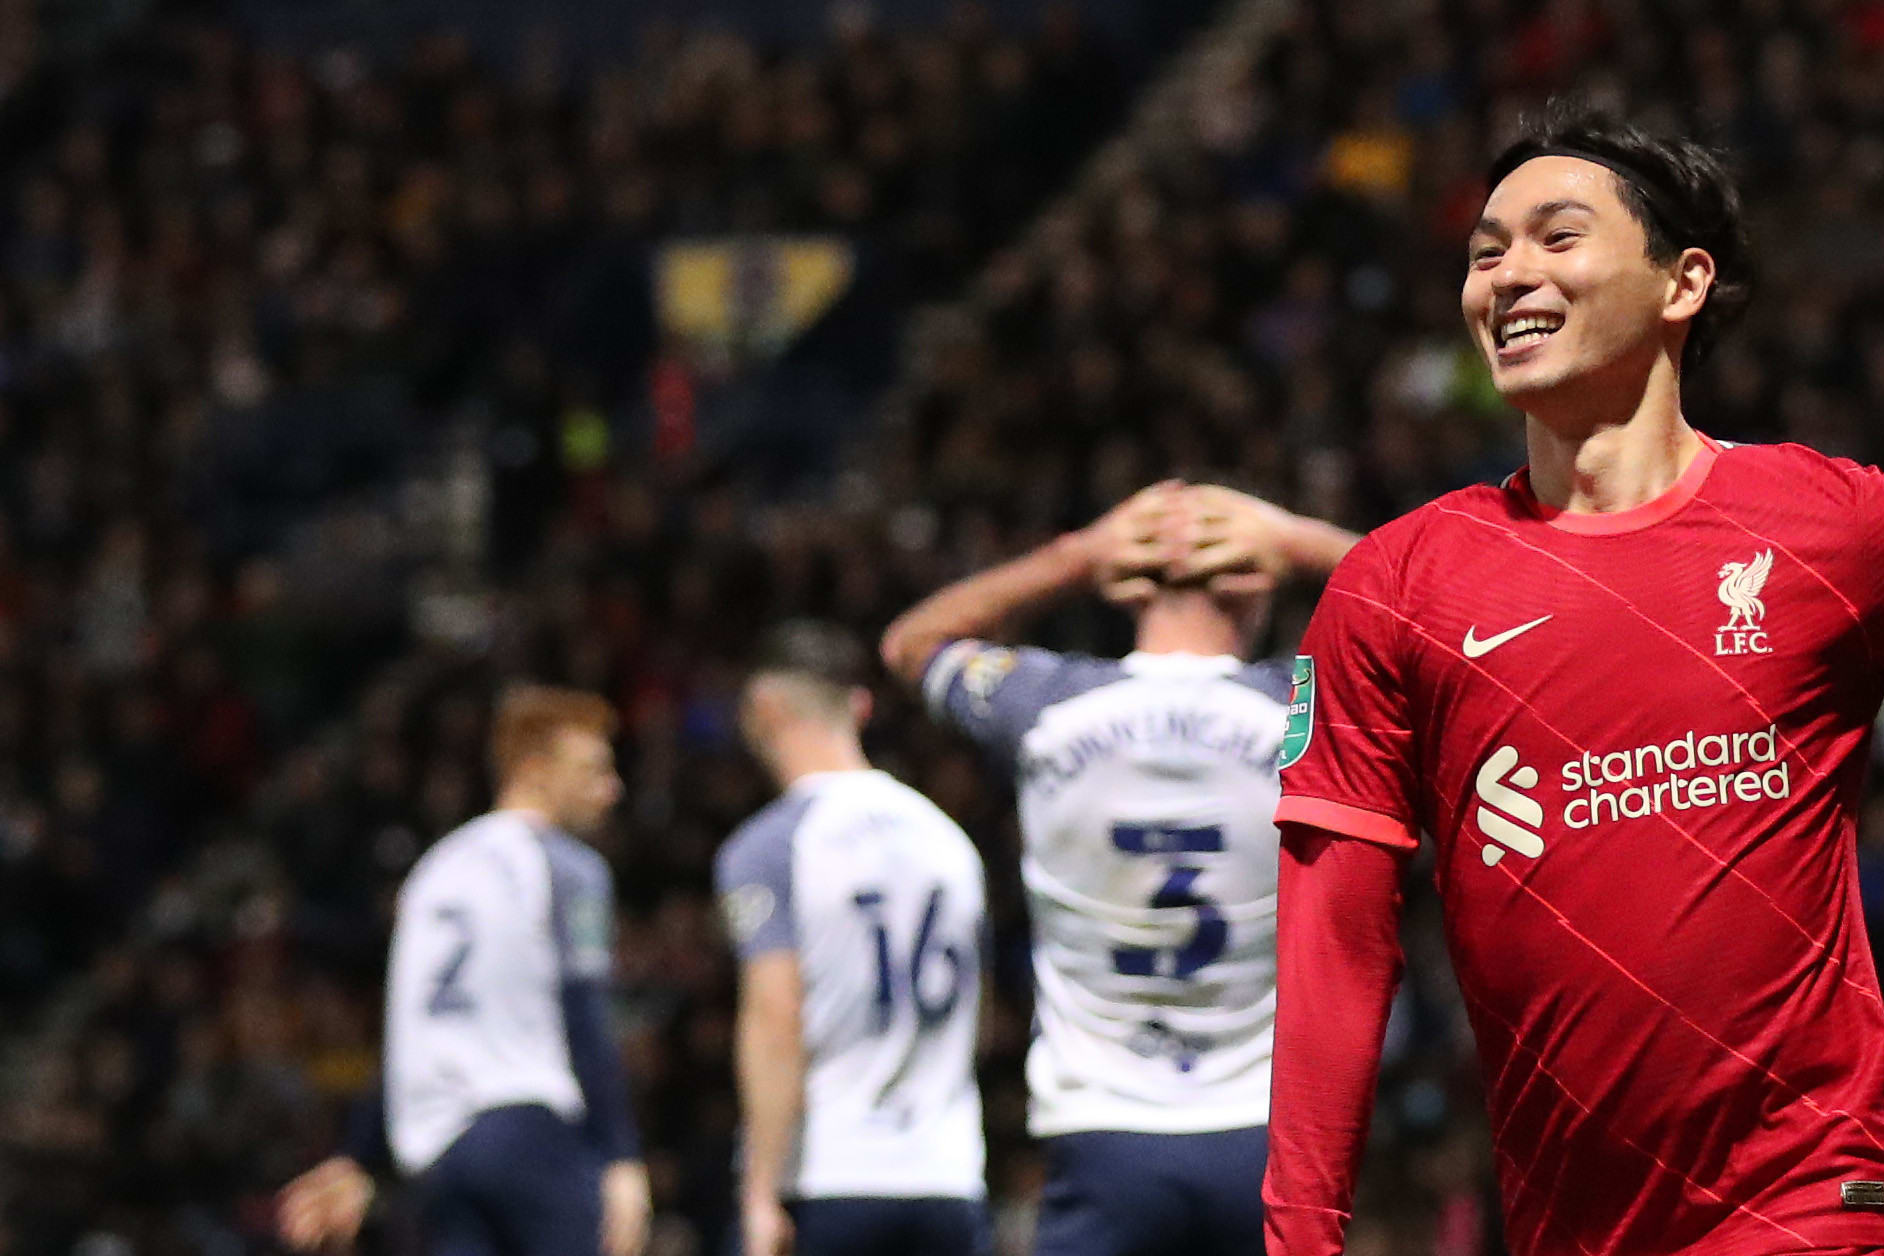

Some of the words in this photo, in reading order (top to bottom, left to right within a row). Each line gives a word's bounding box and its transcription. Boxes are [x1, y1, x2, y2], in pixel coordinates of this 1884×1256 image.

[1714, 632, 1775, 656] L.F.C.
[1561, 723, 1777, 792] standard
[1563, 761, 1790, 829] chartered
[1111, 821, 1231, 979] 3
[427, 903, 475, 1018] 2
[851, 881, 962, 1032] 16
